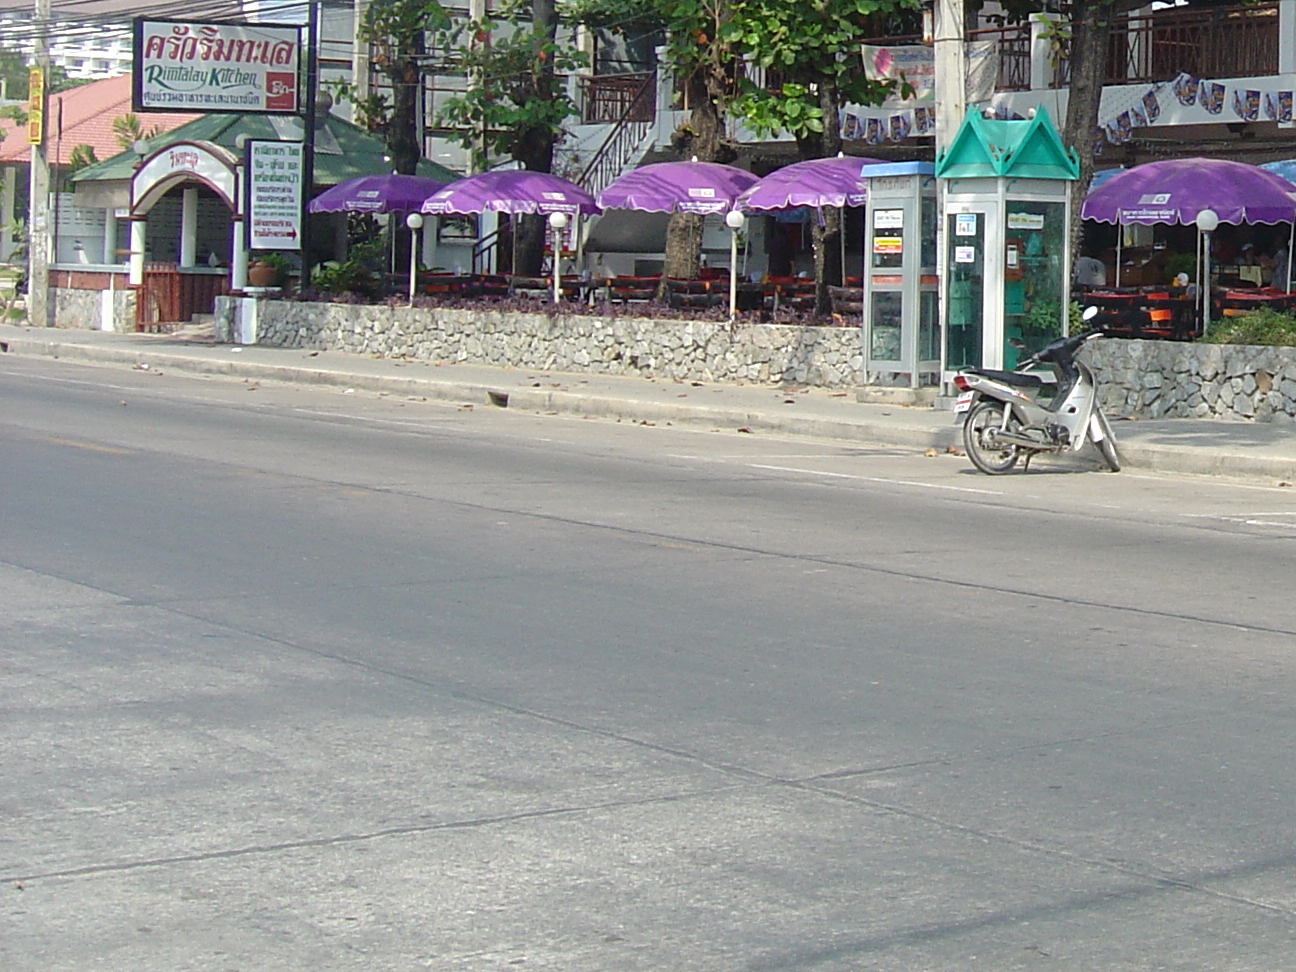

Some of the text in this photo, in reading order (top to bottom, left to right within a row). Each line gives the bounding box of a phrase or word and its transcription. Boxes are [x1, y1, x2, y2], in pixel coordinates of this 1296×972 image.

[144, 25, 296, 66] ครัวริมทะเล
[144, 64, 262, 91] Rimtalay Kitchen
